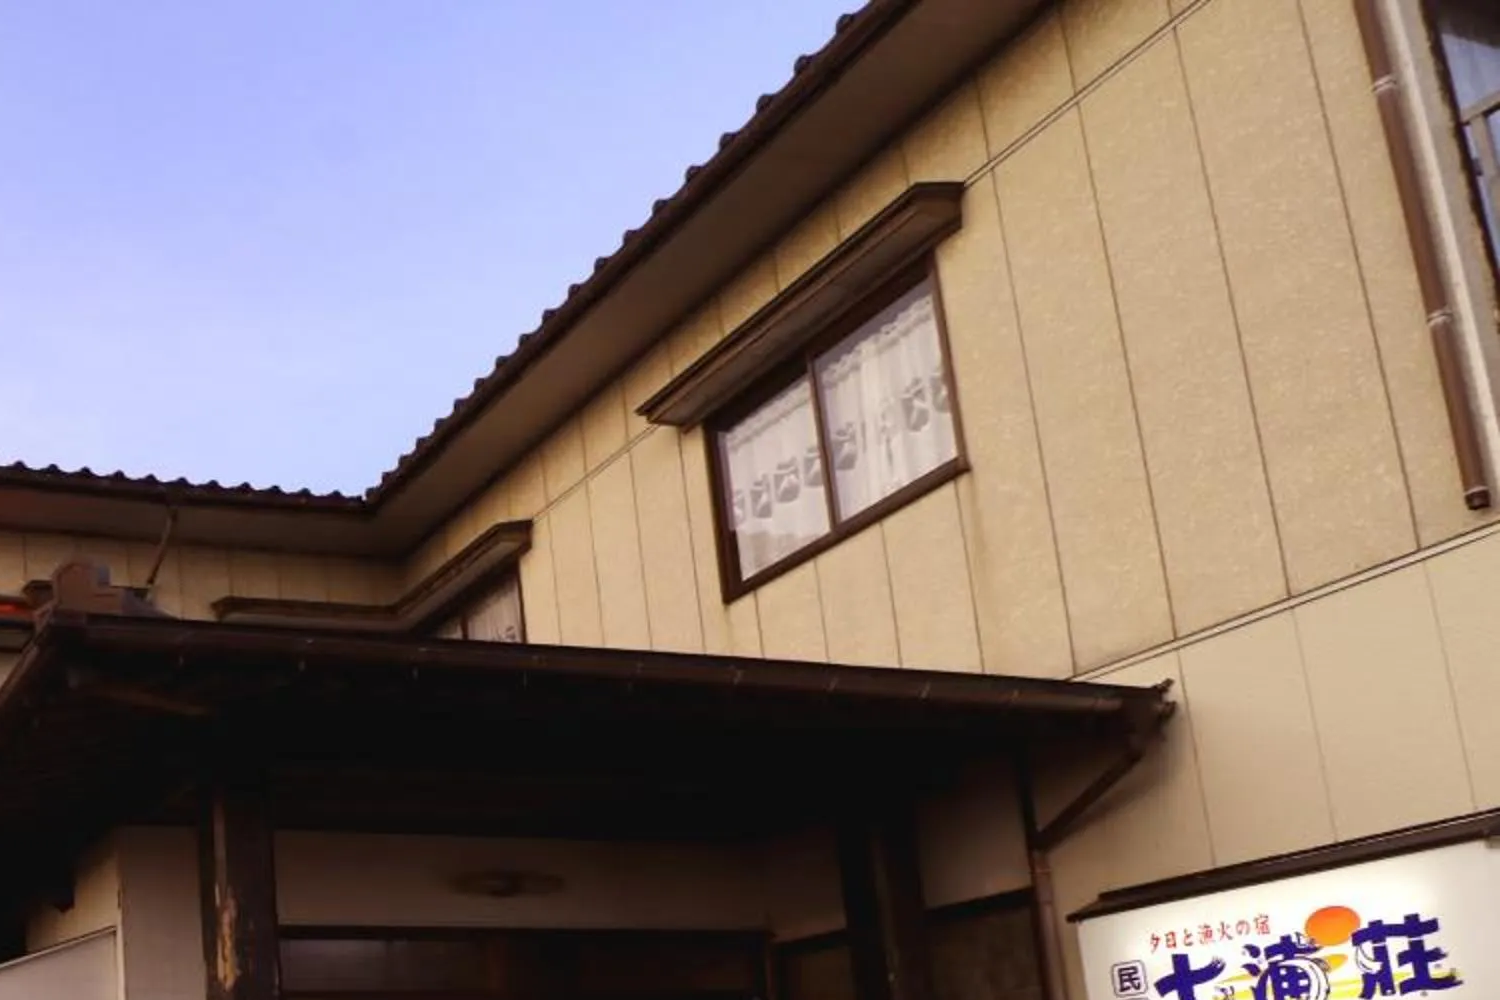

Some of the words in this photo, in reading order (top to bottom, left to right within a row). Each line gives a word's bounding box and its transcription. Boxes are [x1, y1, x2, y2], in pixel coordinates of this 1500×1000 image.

[1150, 913, 1271, 953] 夕日と漁火の宿
